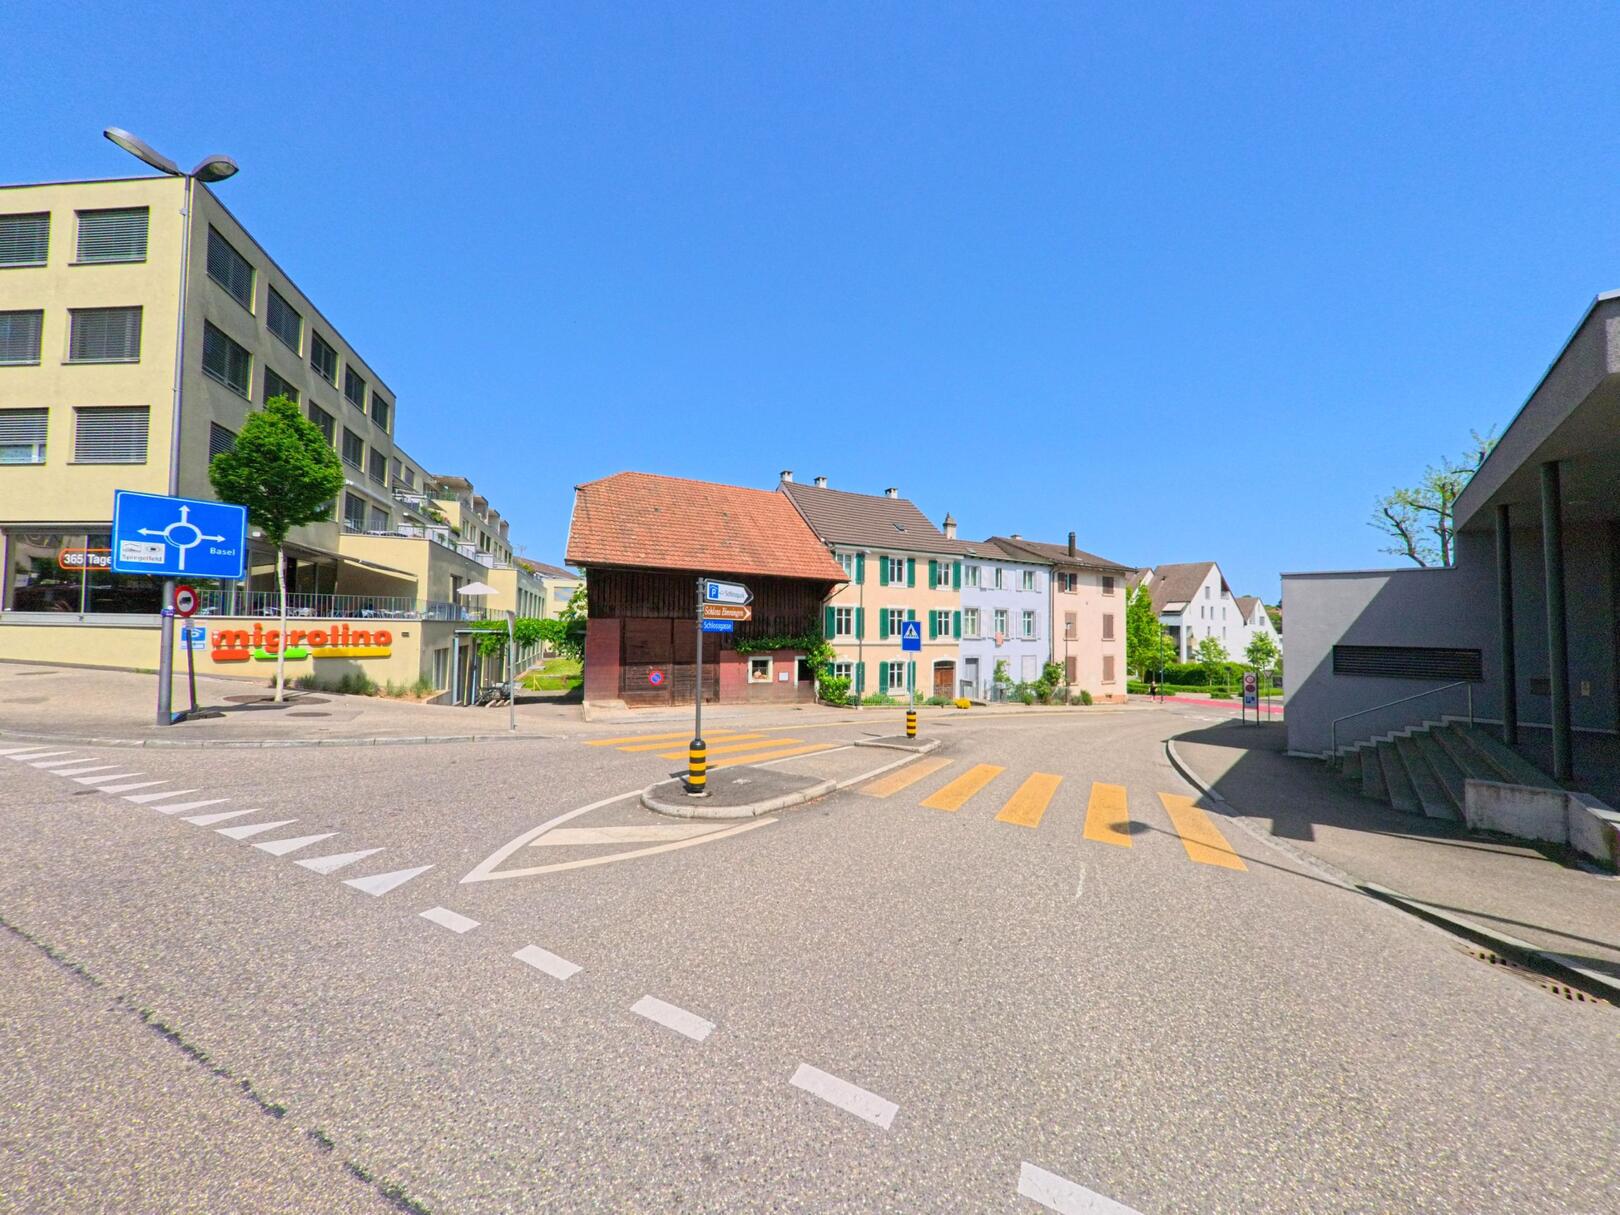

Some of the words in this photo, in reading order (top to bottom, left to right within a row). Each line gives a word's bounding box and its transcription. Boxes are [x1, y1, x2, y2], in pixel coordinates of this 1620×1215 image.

[209, 547, 236, 556] Basel
[63, 553, 84, 564] 365
[87, 553, 112, 567] Tage
[211, 622, 393, 654] migrolino
